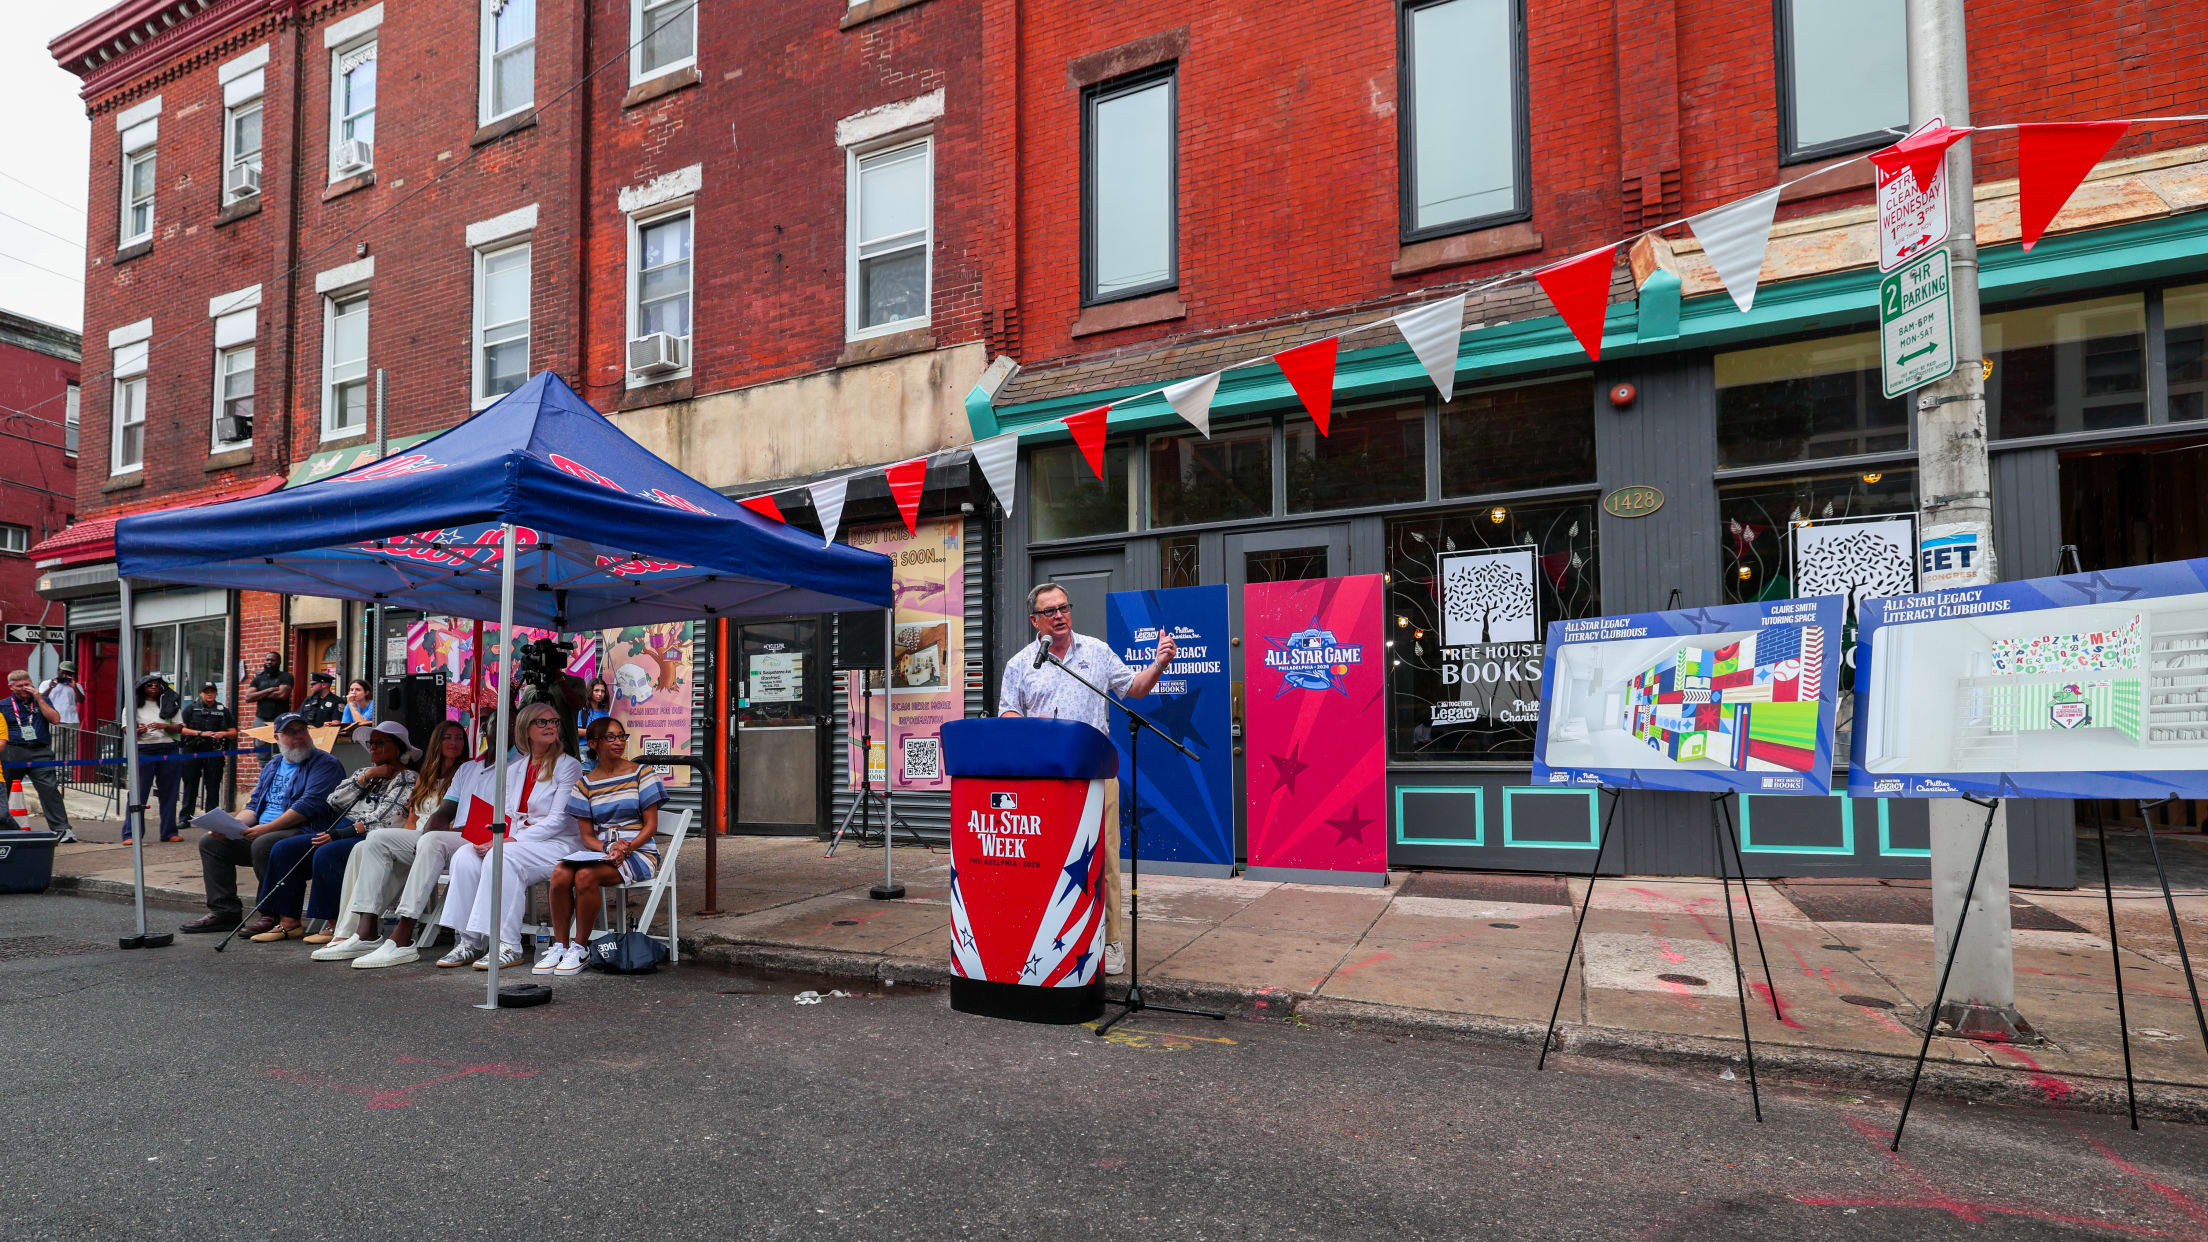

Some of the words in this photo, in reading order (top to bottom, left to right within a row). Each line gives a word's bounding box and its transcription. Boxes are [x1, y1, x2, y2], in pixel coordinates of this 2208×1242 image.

[1884, 183, 1941, 228] WEDNESDAY
[1886, 284, 1898, 316] 2
[1914, 264, 1931, 285] HR
[1903, 275, 1945, 309] PARKING
[1899, 313, 1934, 336] 8AM-6PM
[1900, 327, 1933, 348] MON-SAT
[1613, 491, 1655, 511] 1428
[851, 530, 880, 546] PLOT
[1927, 571, 1978, 582] CONGRESS
[1937, 590, 1983, 606] LEGACY
[1771, 605, 1795, 615] CLAIRE
[1795, 602, 1817, 612] SMITH
[1883, 608, 1937, 623] LITERACY
[1938, 599, 2011, 617] CLUBHOUSE
[1600, 618, 1630, 629] LEGACY
[1761, 616, 1793, 625] TUTORING
[1794, 613, 1816, 622] SPACE
[27, 630, 40, 639] ON
[50, 631, 63, 639] WA
[1134, 631, 1159, 640] Legacy
[1565, 632, 1599, 642] LITERACY
[1601, 627, 1648, 639] CLUBHOUSE
[1174, 646, 1207, 659] EGACY
[1324, 647, 1361, 664] GAME
[1440, 647, 1480, 661] TREE
[1486, 644, 1543, 660] HOUSE
[1442, 660, 1542, 685] BOOKS
[435, 675, 444, 686] B
[630, 708, 644, 716] SCAN
[660, 707, 672, 715] FOR
[891, 702, 910, 711] SCAN
[911, 702, 930, 711] HERE
[931, 701, 951, 710] MORE
[1513, 700, 1540, 712] Phill
[899, 716, 943, 725] INFORMATION
[1430, 705, 1480, 722] Legacy
[1874, 781, 1905, 790] Legacy
[1925, 779, 1950, 787] Phillies
[977, 834, 1026, 858] WEEK
[969, 858, 1017, 866] PHILADELPHIA
